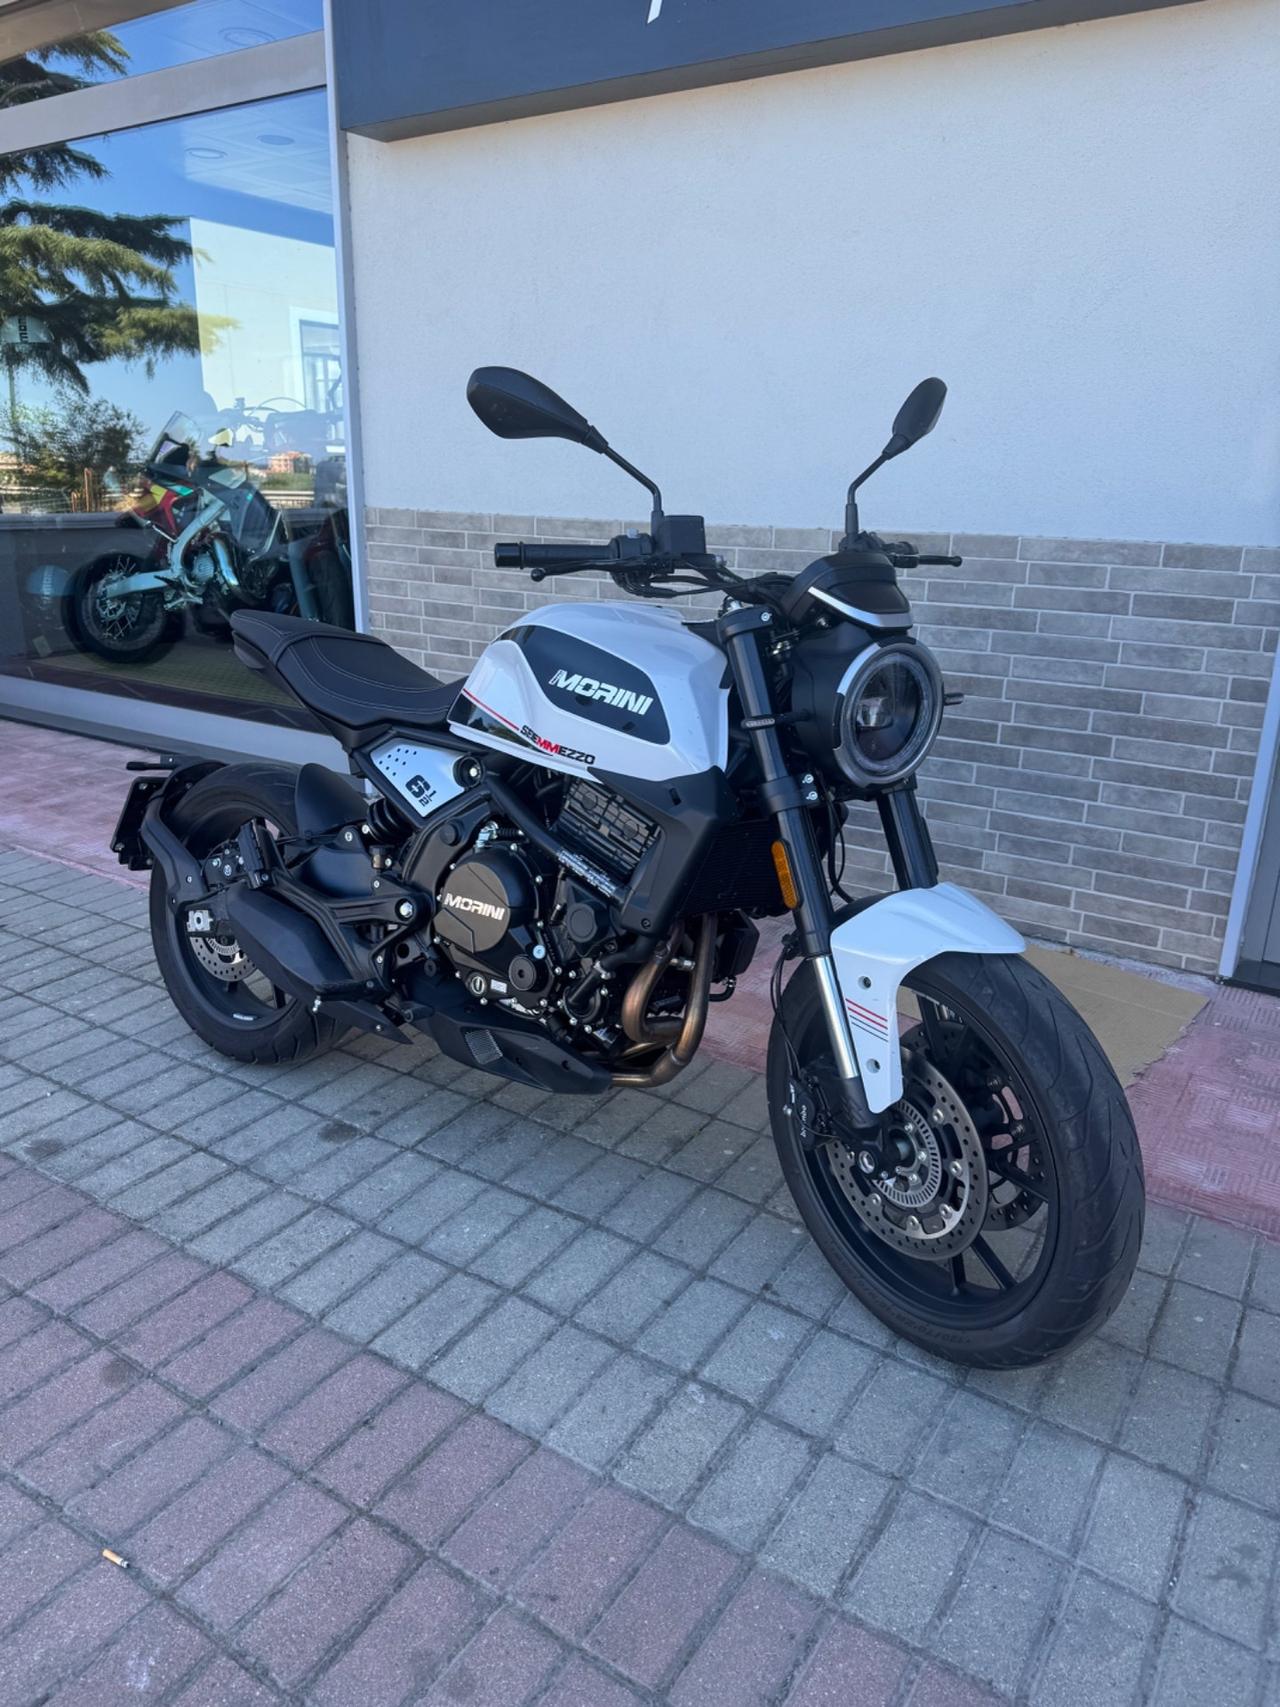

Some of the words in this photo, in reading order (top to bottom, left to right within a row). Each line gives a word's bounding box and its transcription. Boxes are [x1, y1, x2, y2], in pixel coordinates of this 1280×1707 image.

[554, 669, 654, 715] MORINI
[405, 774, 431, 799] 6
[444, 892, 506, 921] MORINI
